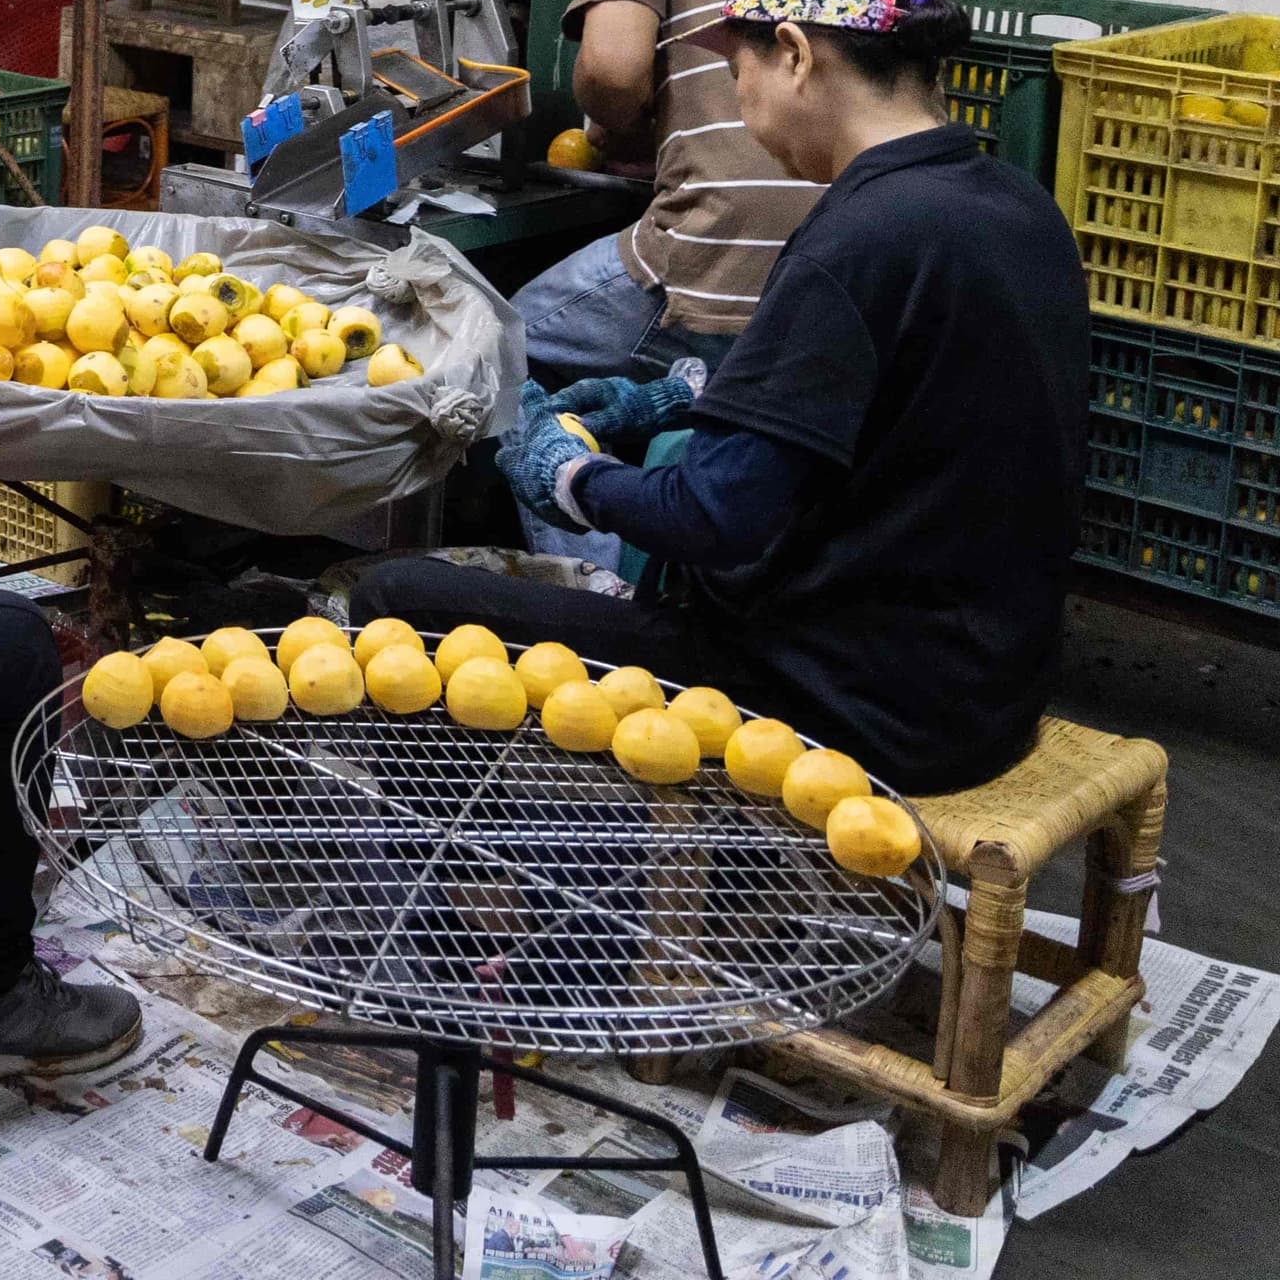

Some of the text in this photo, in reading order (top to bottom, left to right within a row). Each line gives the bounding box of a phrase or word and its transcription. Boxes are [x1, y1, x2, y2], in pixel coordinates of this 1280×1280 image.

[1205, 964, 1228, 979] an
[1185, 977, 1224, 1007] Attack
[1175, 1003, 1200, 1020] on
[1204, 988, 1250, 1024] Vaccine
